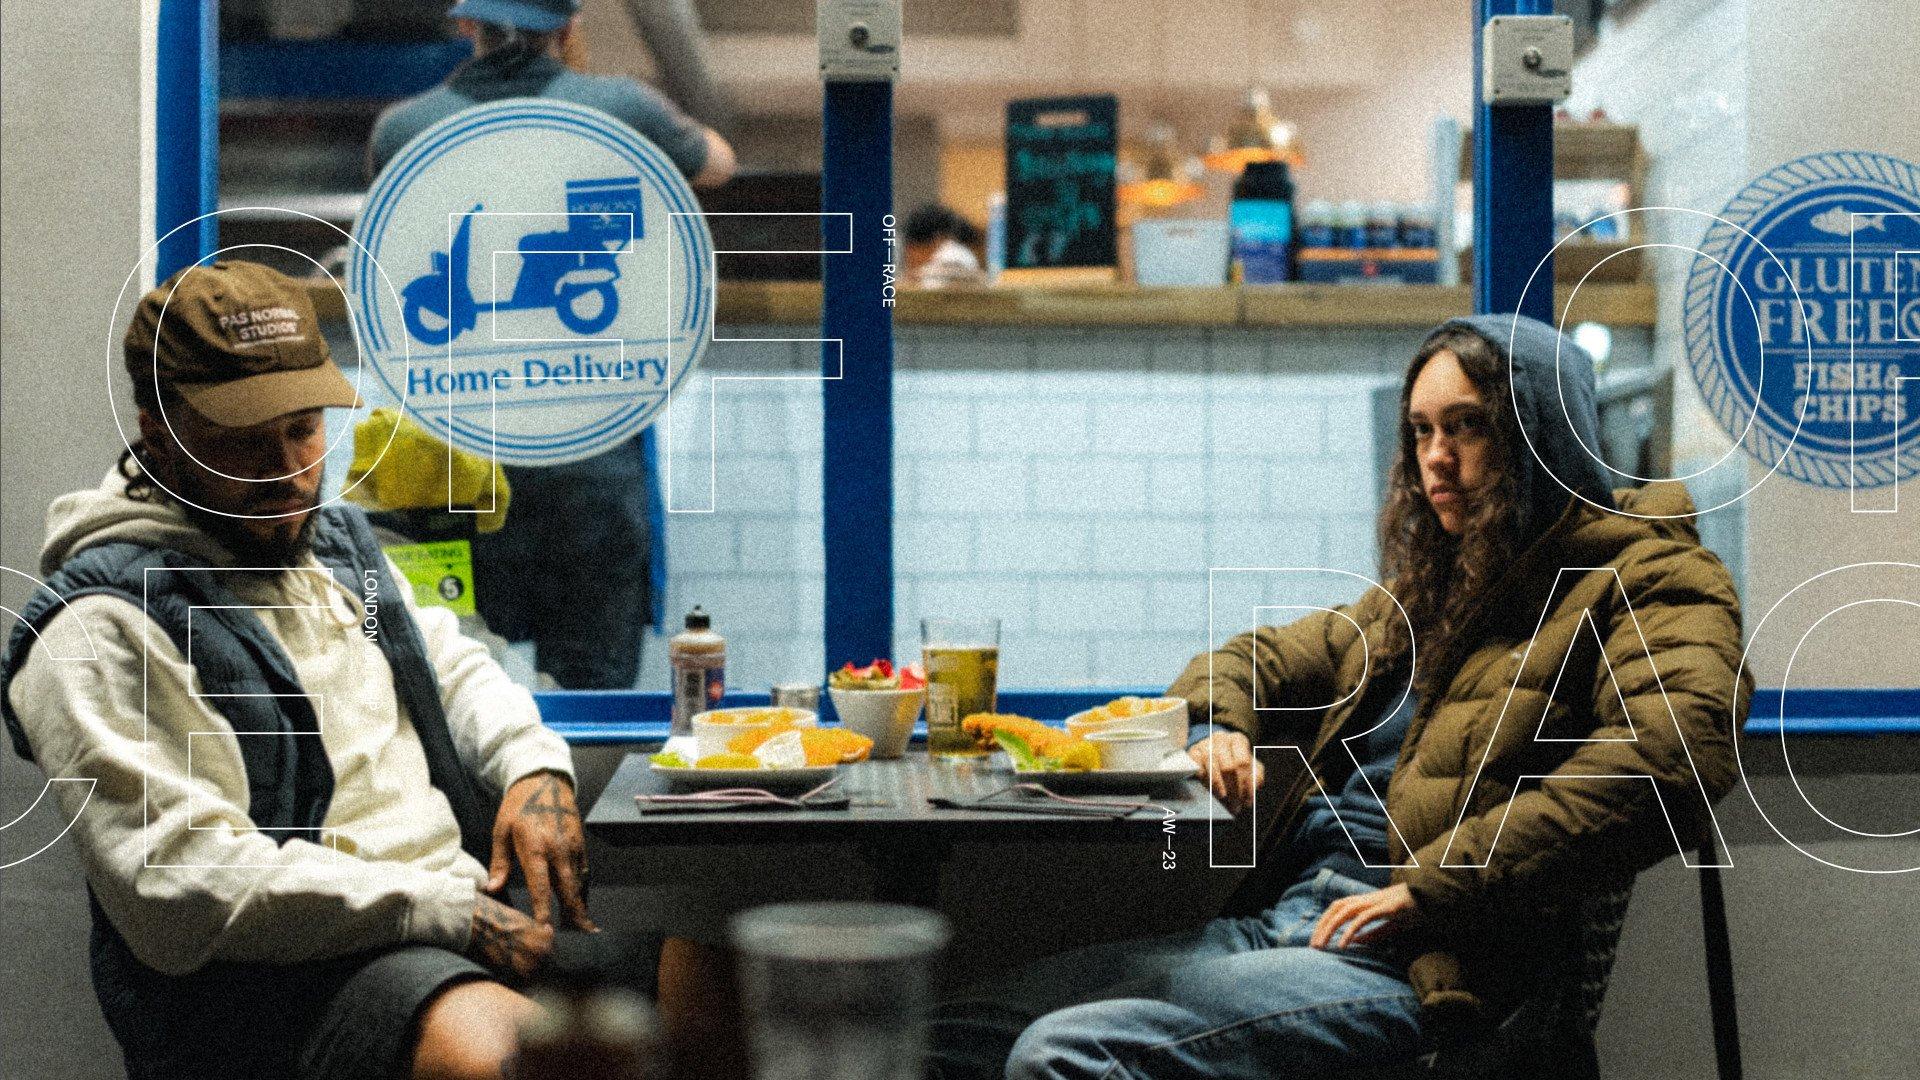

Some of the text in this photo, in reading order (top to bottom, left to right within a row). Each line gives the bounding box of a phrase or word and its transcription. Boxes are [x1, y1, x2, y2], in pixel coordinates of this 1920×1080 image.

[1753, 256, 1920, 295] GLUTE
[220, 311, 250, 330] PAS
[1757, 298, 1898, 344] FREE
[407, 353, 668, 396] Home Delivery
[1793, 393, 1908, 424] CHIPS
